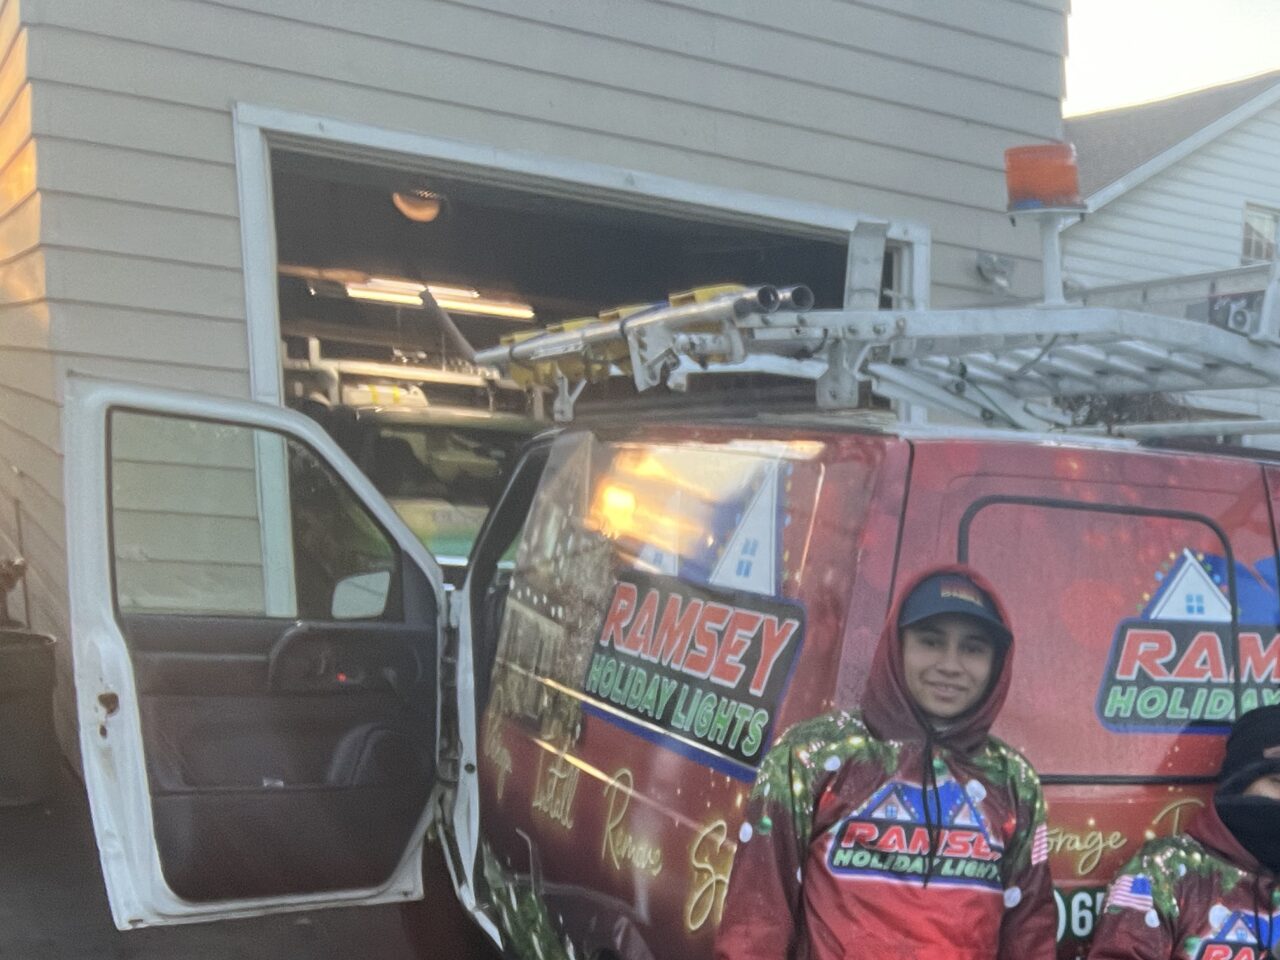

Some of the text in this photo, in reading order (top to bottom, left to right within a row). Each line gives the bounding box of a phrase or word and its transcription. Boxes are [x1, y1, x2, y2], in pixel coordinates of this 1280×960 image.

[600, 582, 799, 697] RAMSEY
[586, 653, 769, 757] HOLIDAY LIGHTS
[841, 822, 1002, 862] RAMSE
